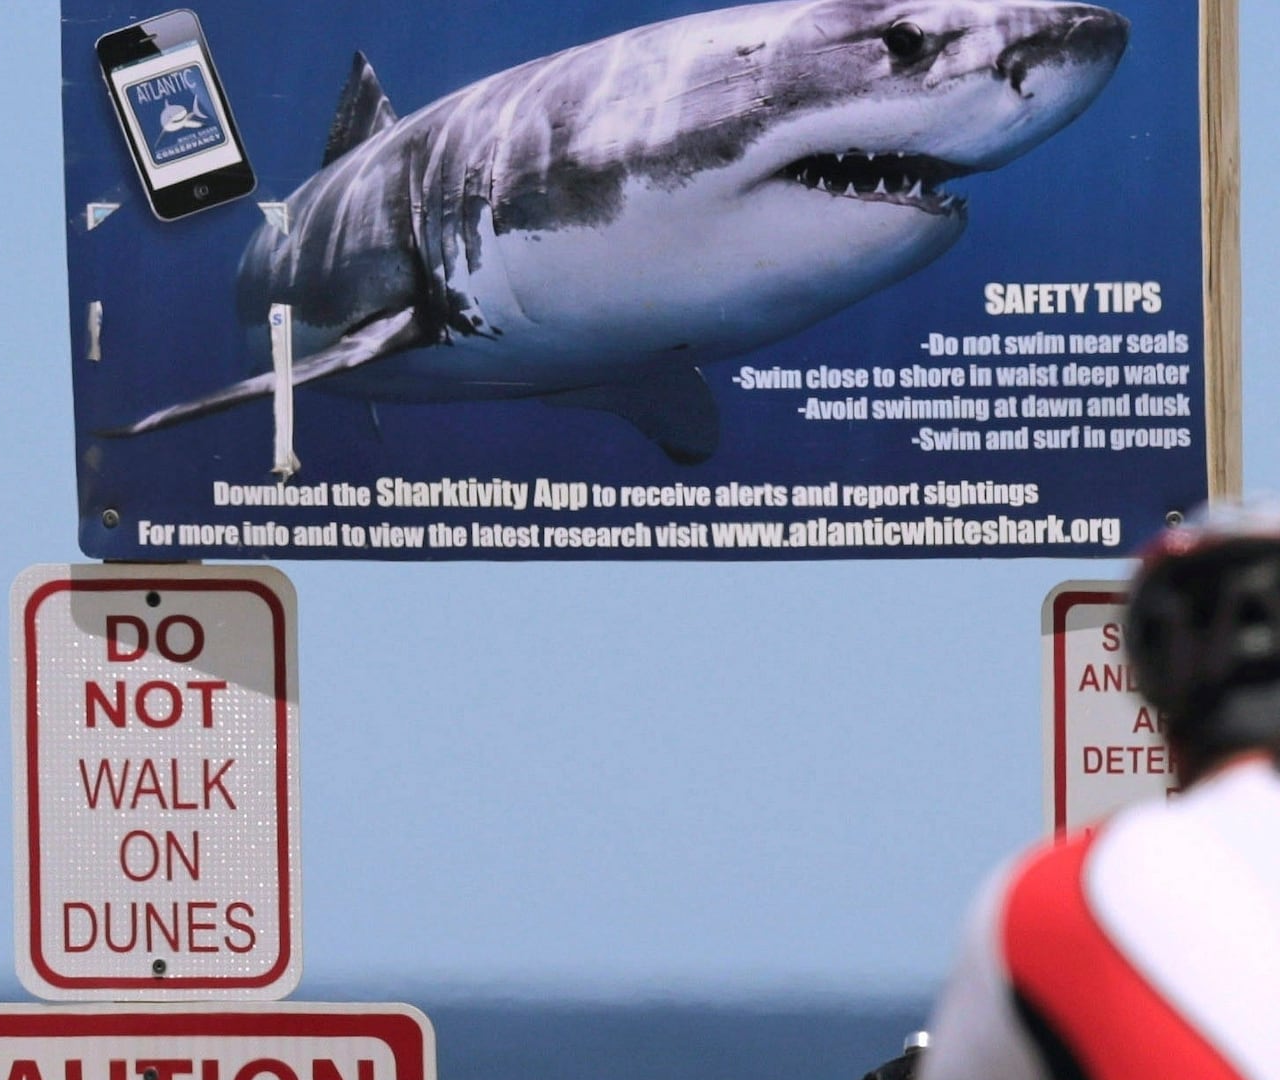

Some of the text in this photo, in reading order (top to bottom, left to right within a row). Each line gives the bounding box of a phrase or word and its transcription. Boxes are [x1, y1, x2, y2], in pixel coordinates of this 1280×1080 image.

[136, 69, 197, 105] ATLANTIC
[984, 281, 1162, 315] SAFETY TIPS
[921, 330, 1189, 356] -Do not swim near seals
[732, 362, 1190, 389] -Swim close to shore in waist deep water
[798, 393, 1191, 421] -Avoid swimming at dawn and dusk
[911, 425, 1191, 451] -Swim and surf in groups
[213, 477, 1039, 511] Download the Sharktivity App to receive alerts and report sightings
[138, 515, 1120, 548] For more info and to view the latest research visit www.atlanticwhiteshark.org
[106, 615, 205, 662] DO
[85, 681, 227, 728] NOT
[79, 758, 236, 810] WALK
[120, 830, 199, 882] ON
[63, 902, 256, 953] DUNES
